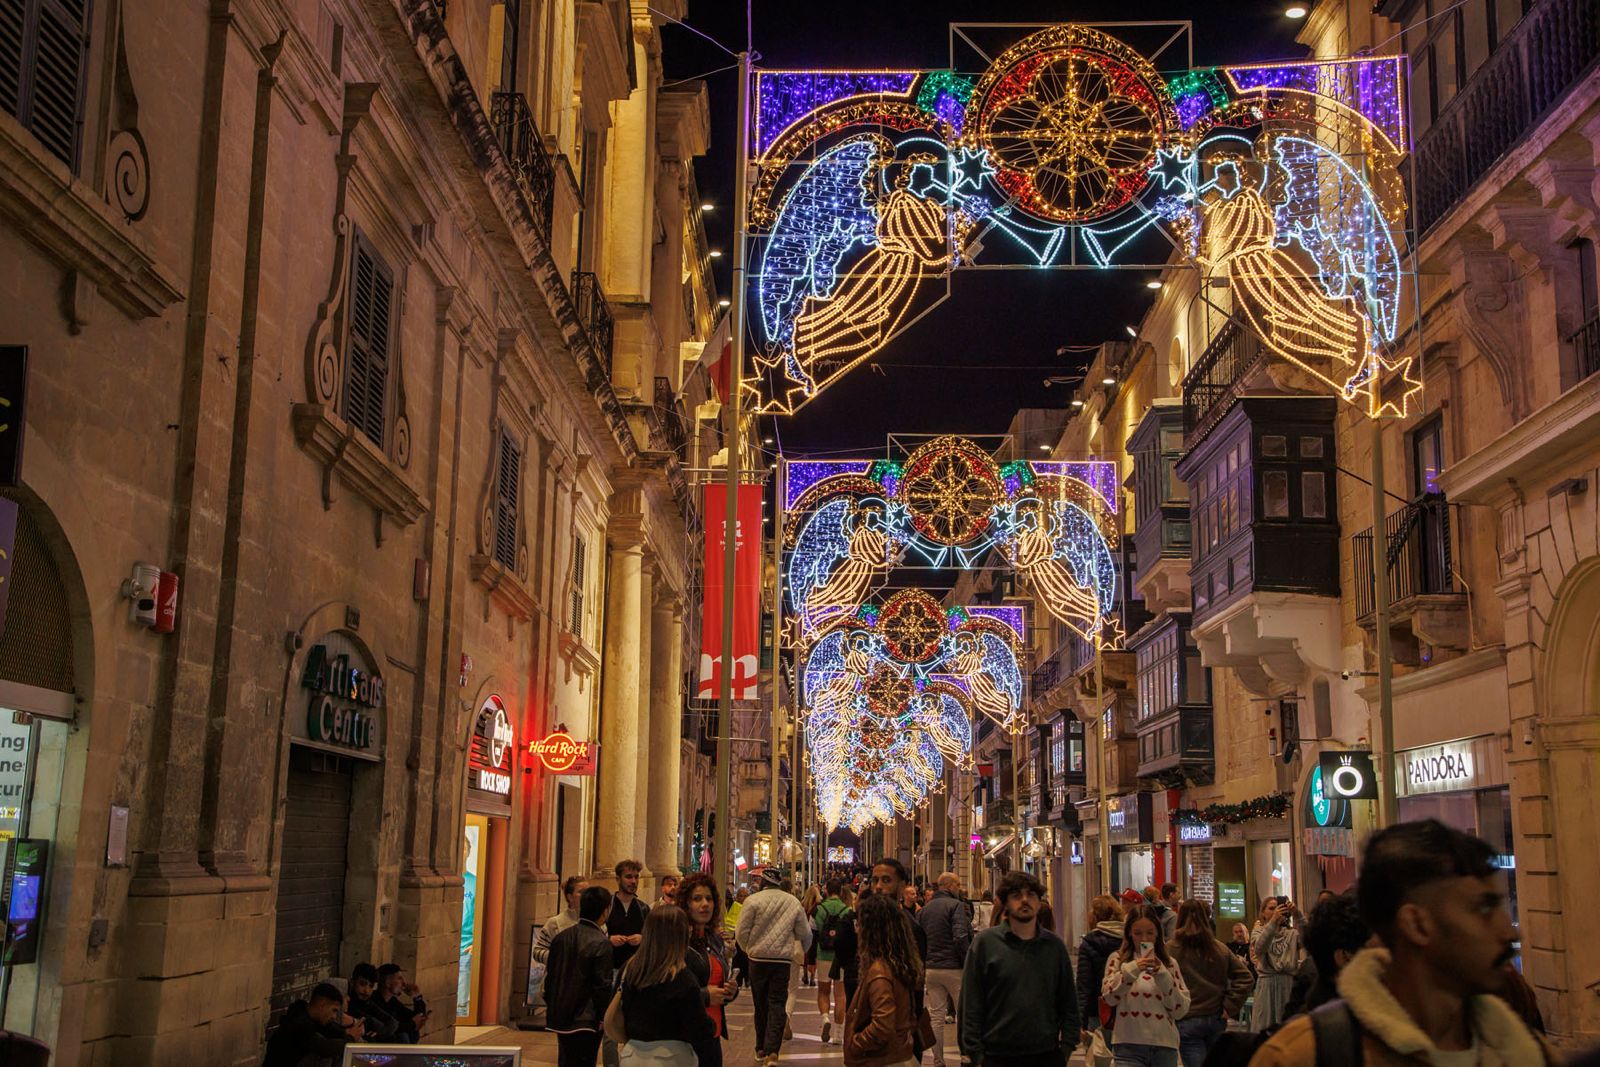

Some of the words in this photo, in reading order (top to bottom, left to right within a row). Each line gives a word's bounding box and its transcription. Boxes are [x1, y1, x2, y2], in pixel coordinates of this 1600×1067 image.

[303, 645, 383, 708] Artisans
[308, 696, 378, 747] Centre
[0, 736, 25, 752] ng
[528, 741, 560, 754] Hard
[560, 742, 588, 757] Rock
[1408, 747, 1469, 784] PANDORA
[480, 769, 495, 791] ROCK
[495, 774, 510, 795] SHOP
